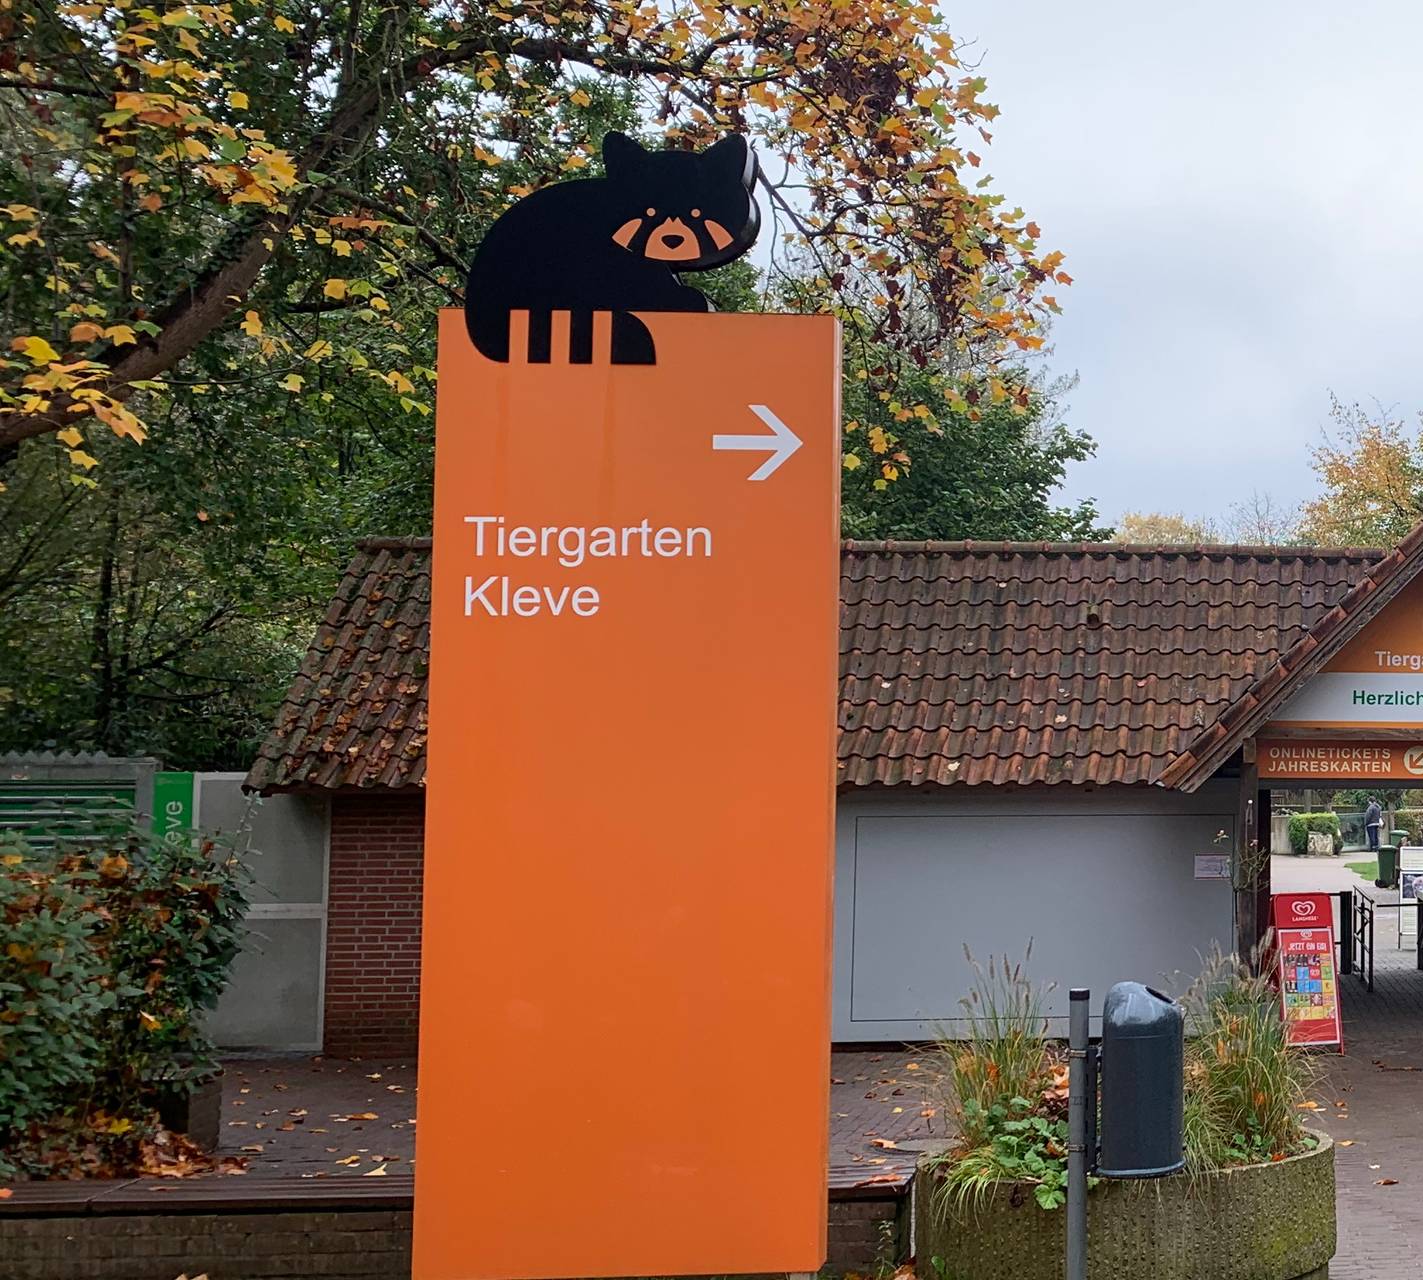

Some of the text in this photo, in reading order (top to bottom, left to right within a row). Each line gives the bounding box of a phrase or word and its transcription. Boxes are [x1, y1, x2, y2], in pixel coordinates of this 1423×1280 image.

[464, 516, 712, 568] Tiergarten
[464, 576, 600, 617] Kleve
[1268, 760, 1392, 773] JAHRESKARTEN
[1269, 747, 1392, 760] ONLINETICKETS
[164, 801, 184, 846] eve
